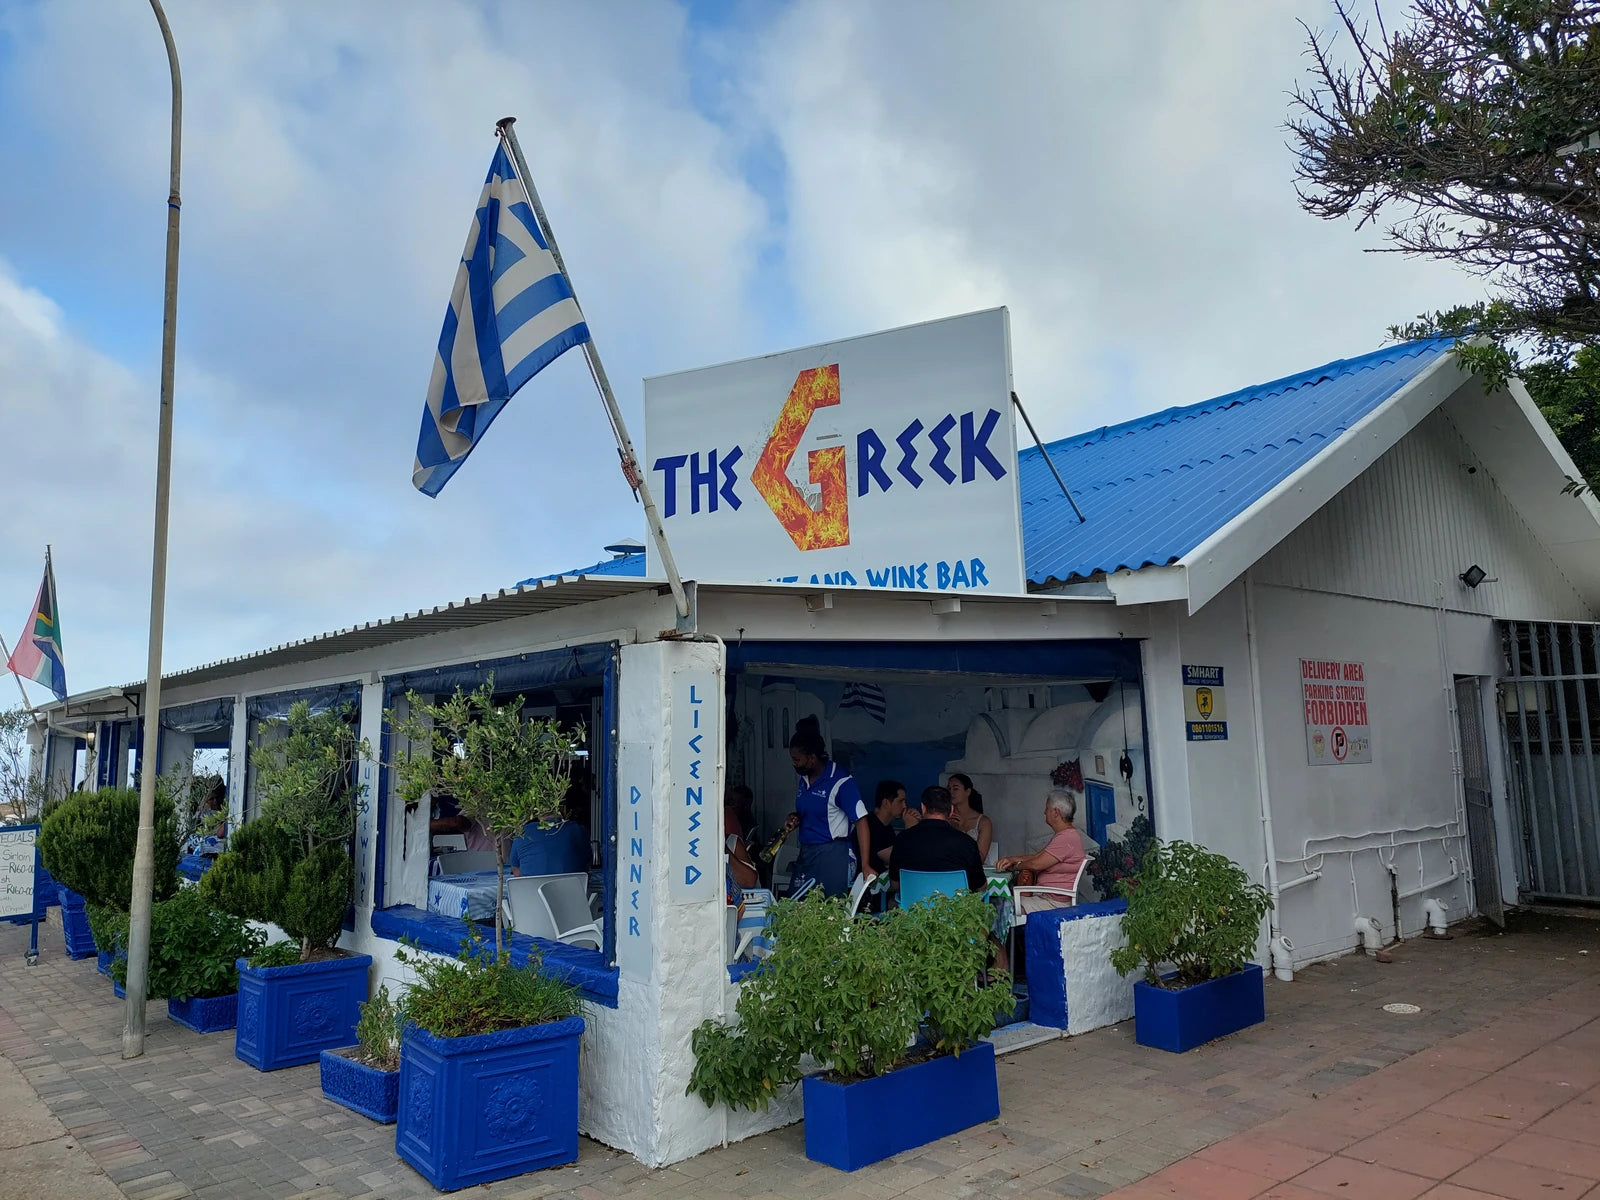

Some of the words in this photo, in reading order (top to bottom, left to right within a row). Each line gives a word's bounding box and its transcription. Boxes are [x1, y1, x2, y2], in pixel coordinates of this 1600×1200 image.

[652, 445, 743, 518] THE
[751, 363, 1007, 551] GREEK
[866, 562, 938, 589] WINE
[937, 557, 989, 590] BAR
[1187, 666, 1219, 678] SMHART
[1301, 660, 1341, 681] DELIVERY
[1344, 663, 1364, 681] AREA
[1304, 684, 1333, 699] PARKING
[1336, 686, 1365, 700] STRICTLY
[1305, 700, 1368, 726] FORBIDDEN
[363, 756, 371, 814] UZO
[685, 685, 703, 886] LICENSED
[0, 831, 33, 843] ECIALS
[629, 786, 643, 938] DINNER
